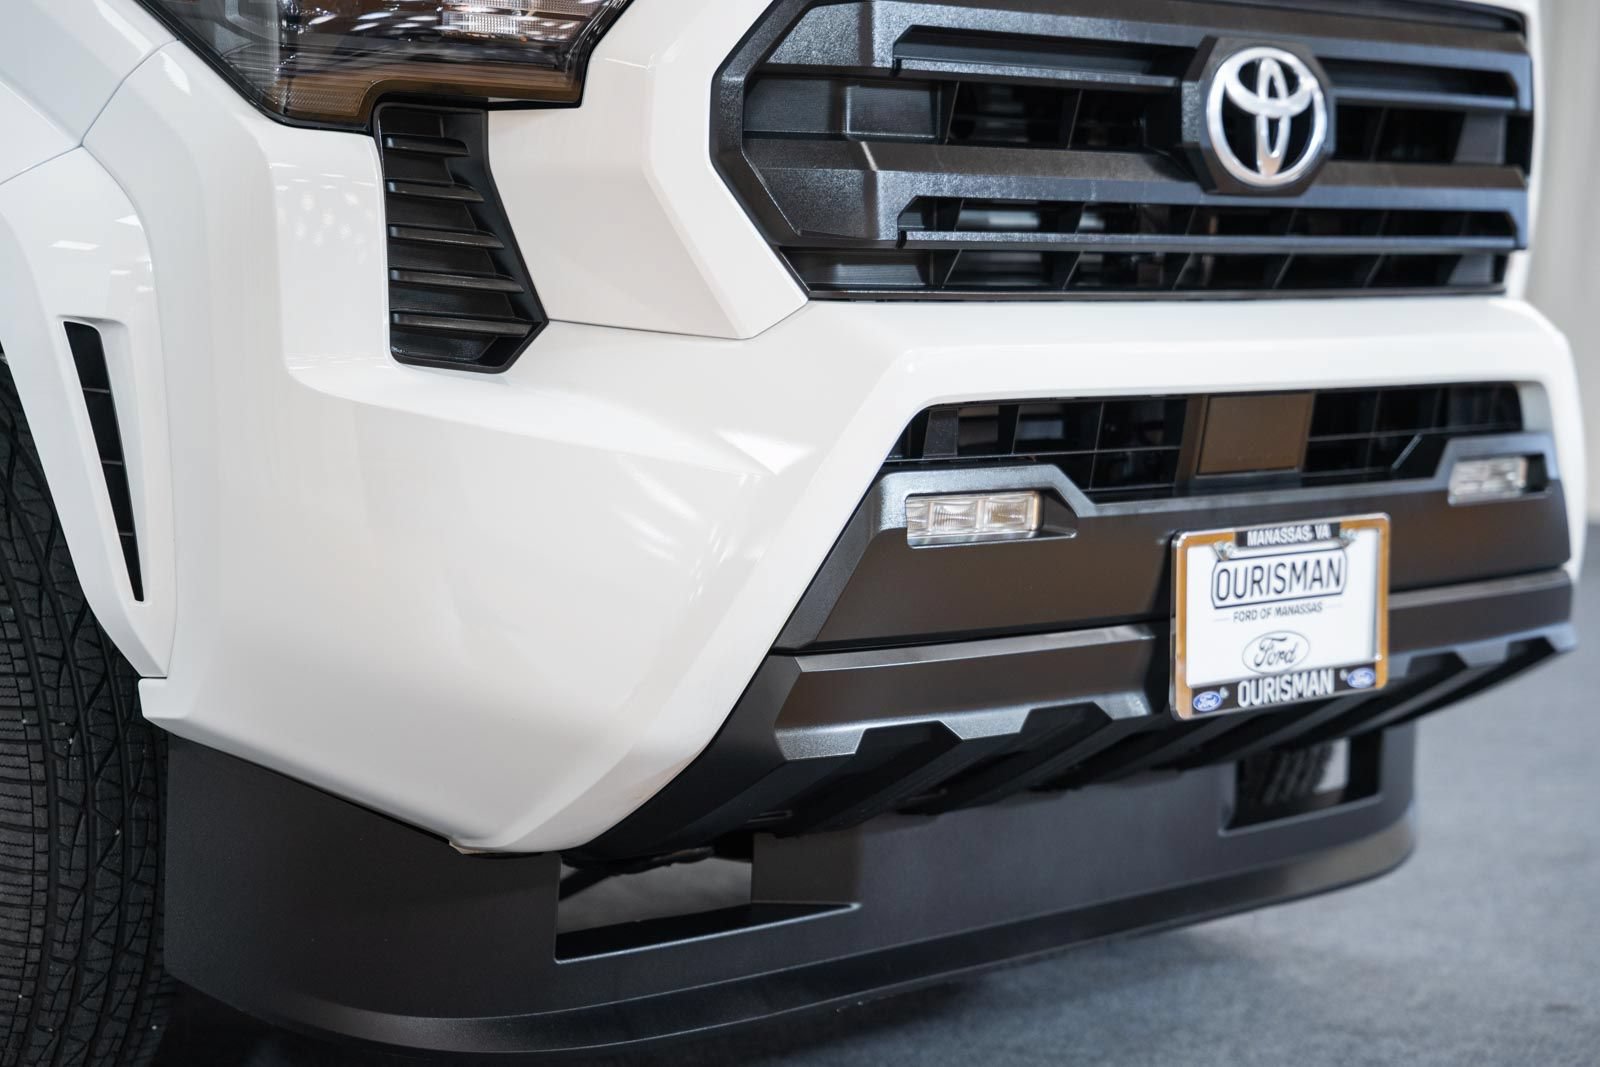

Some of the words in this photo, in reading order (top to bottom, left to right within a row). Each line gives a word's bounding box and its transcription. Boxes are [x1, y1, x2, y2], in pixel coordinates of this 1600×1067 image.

[1315, 524, 1331, 539] VA
[1216, 558, 1342, 601] OURISMAN
[1233, 609, 1258, 622] FORD
[1261, 608, 1272, 620] OF
[1274, 602, 1323, 617] MANASSAS
[1253, 637, 1297, 667] Ford
[1237, 668, 1335, 708] OURISMAN
